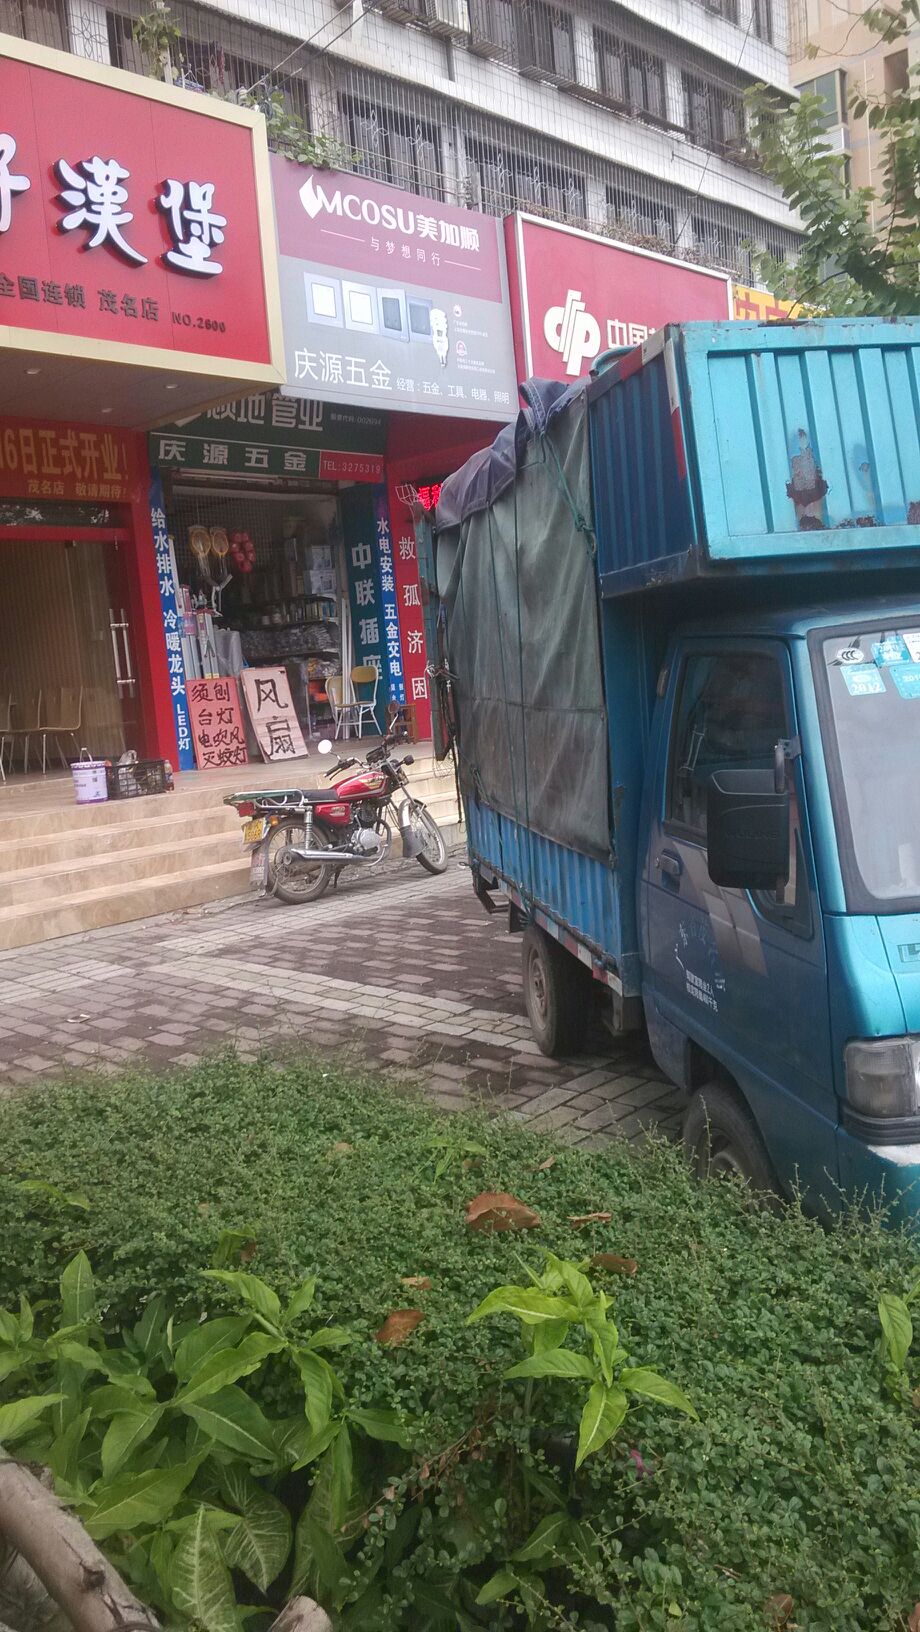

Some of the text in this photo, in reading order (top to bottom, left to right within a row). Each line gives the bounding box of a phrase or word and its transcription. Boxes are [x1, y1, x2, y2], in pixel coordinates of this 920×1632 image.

[370, 237, 441, 267] 与梦想同行
[97, 289, 159, 321] 茂名店
[606, 318, 656, 349] 中国
[294, 347, 392, 390] 庆源五金
[158, 439, 307, 471] 庆源五金
[28, 480, 65, 495] 茂名店
[376, 517, 395, 592] 水电安装
[151, 508, 191, 750] 给水排水 冷暖龙头 LED灯
[399, 536, 428, 700] 救孤济困
[384, 603, 402, 676] 五金交电
[198, 707, 235, 726] 台灯
[254, 678, 296, 756] 风扇
[198, 727, 246, 748] 电吹风
